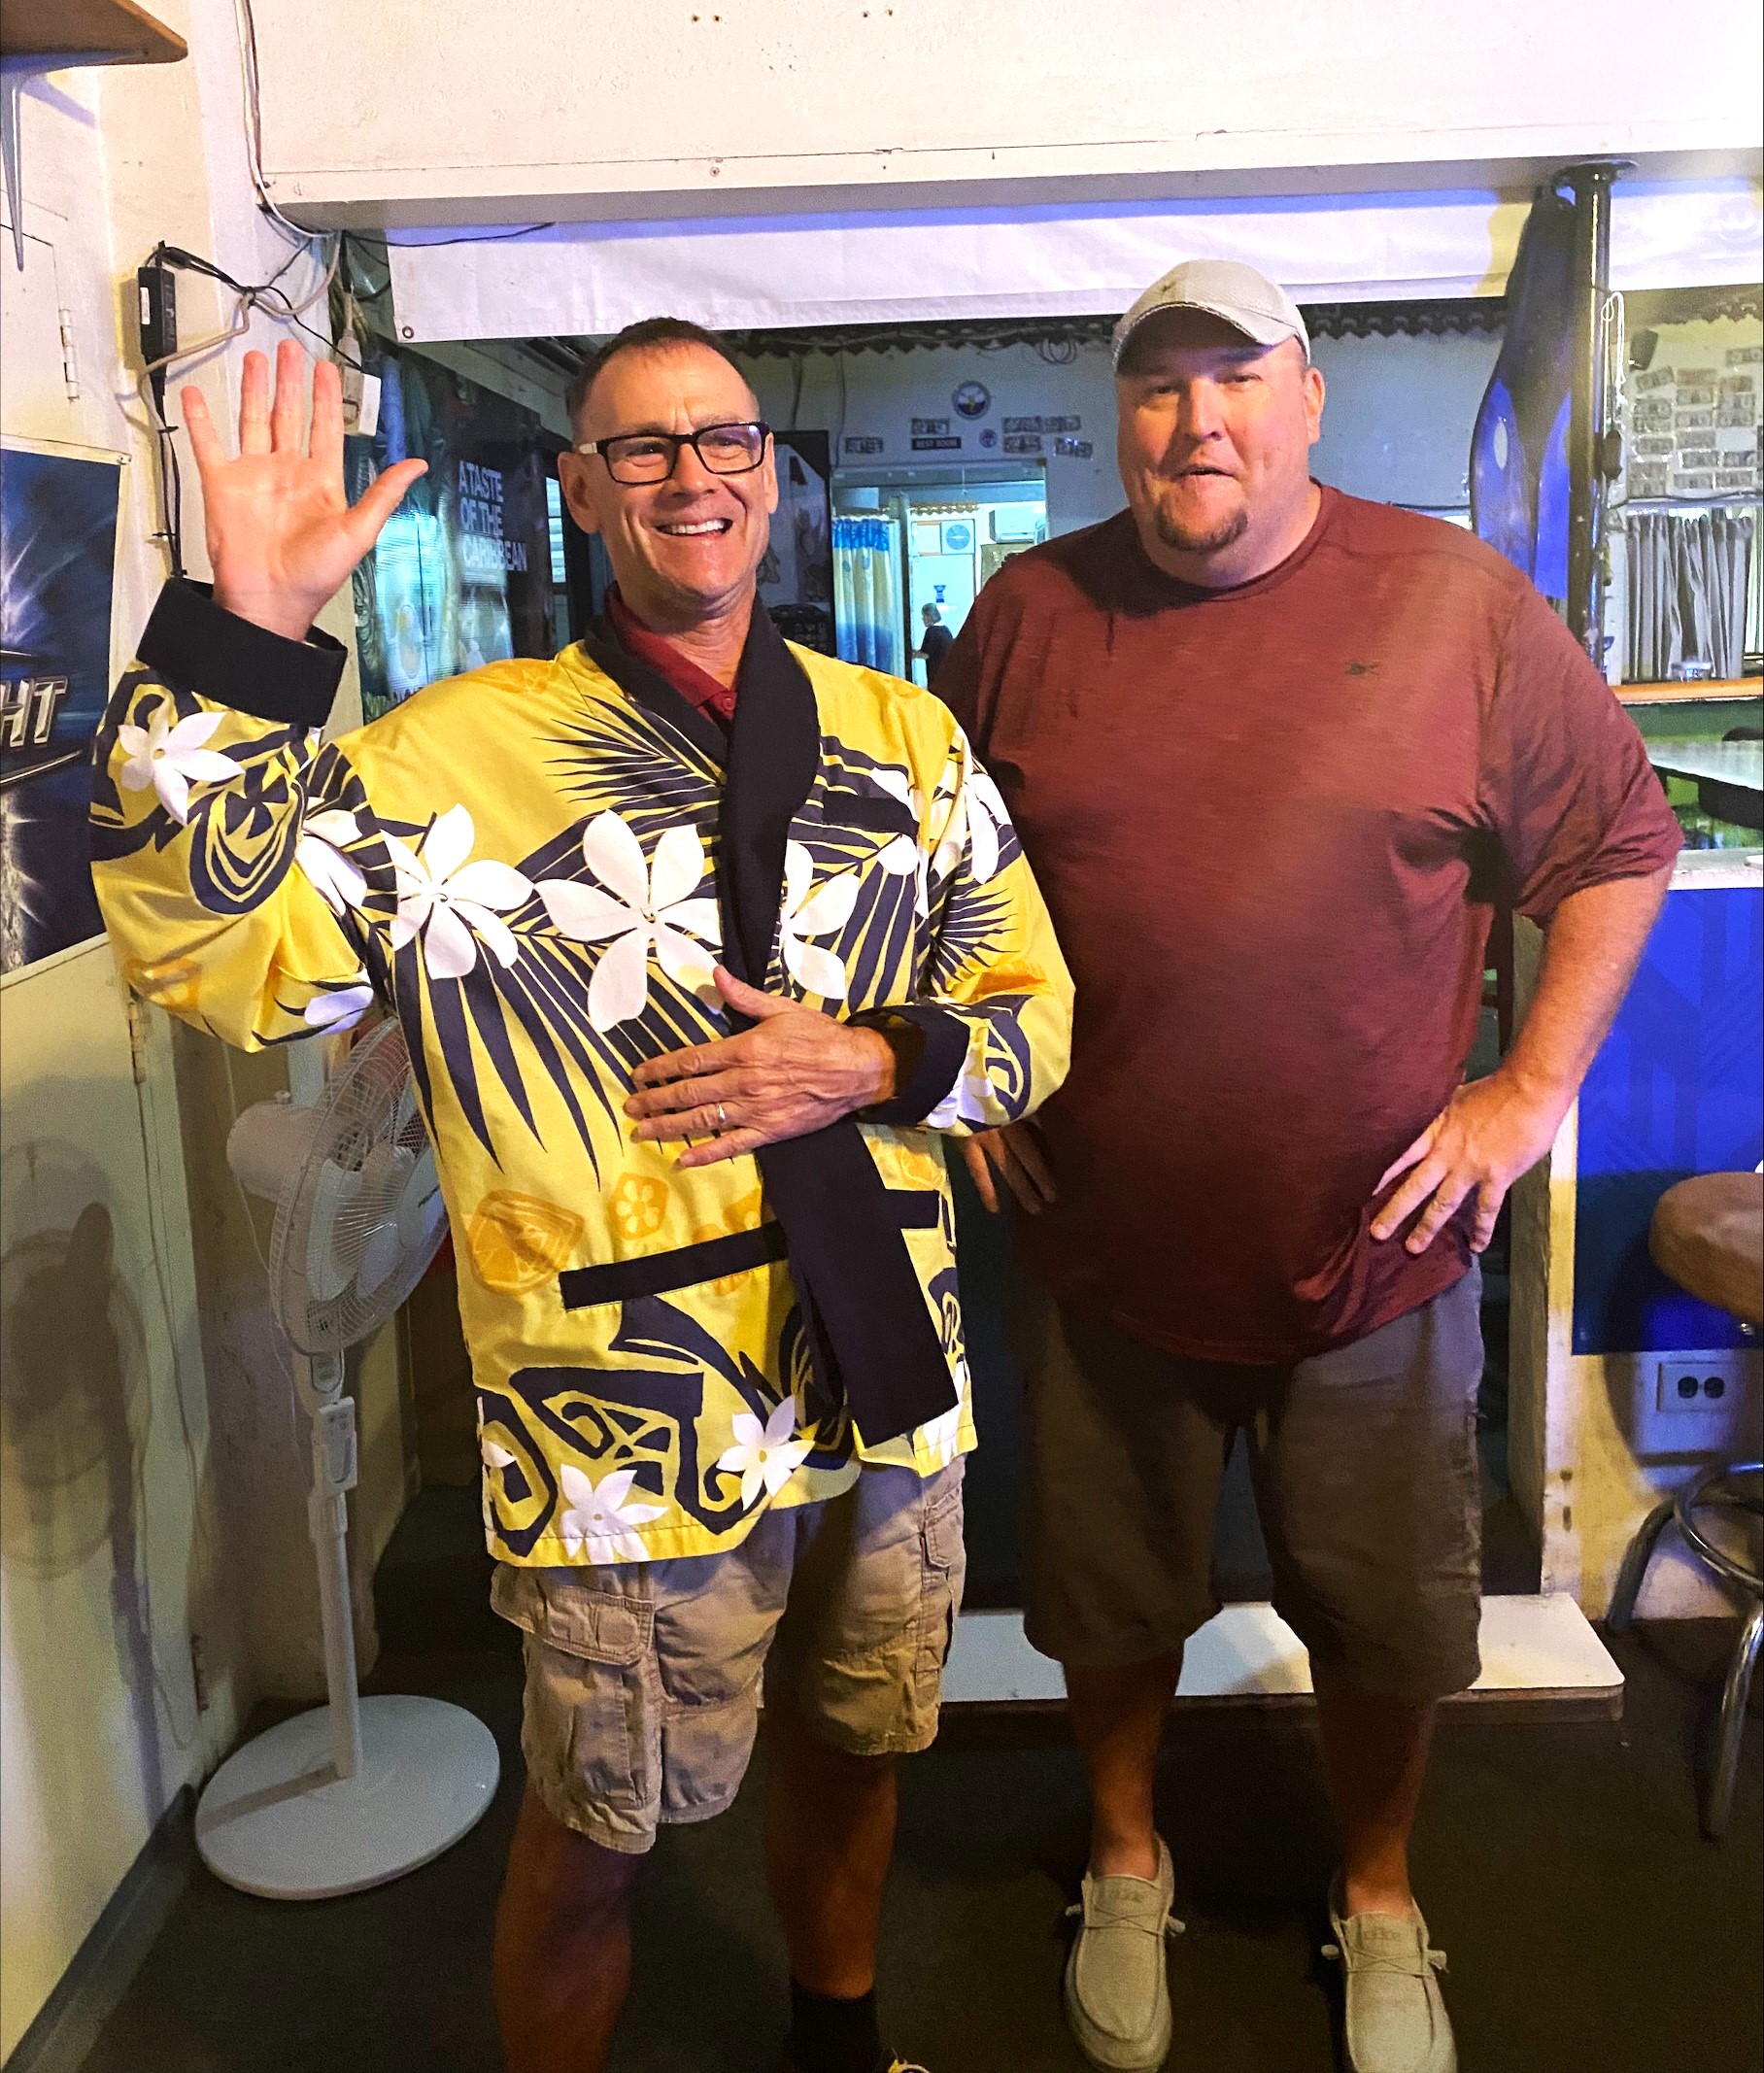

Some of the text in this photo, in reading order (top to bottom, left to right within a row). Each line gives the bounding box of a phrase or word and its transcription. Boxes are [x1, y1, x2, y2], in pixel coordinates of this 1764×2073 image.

[458, 460, 503, 502] A TASTE
[460, 496, 504, 537] OF THE
[462, 534, 527, 572] CARIBBEAN
